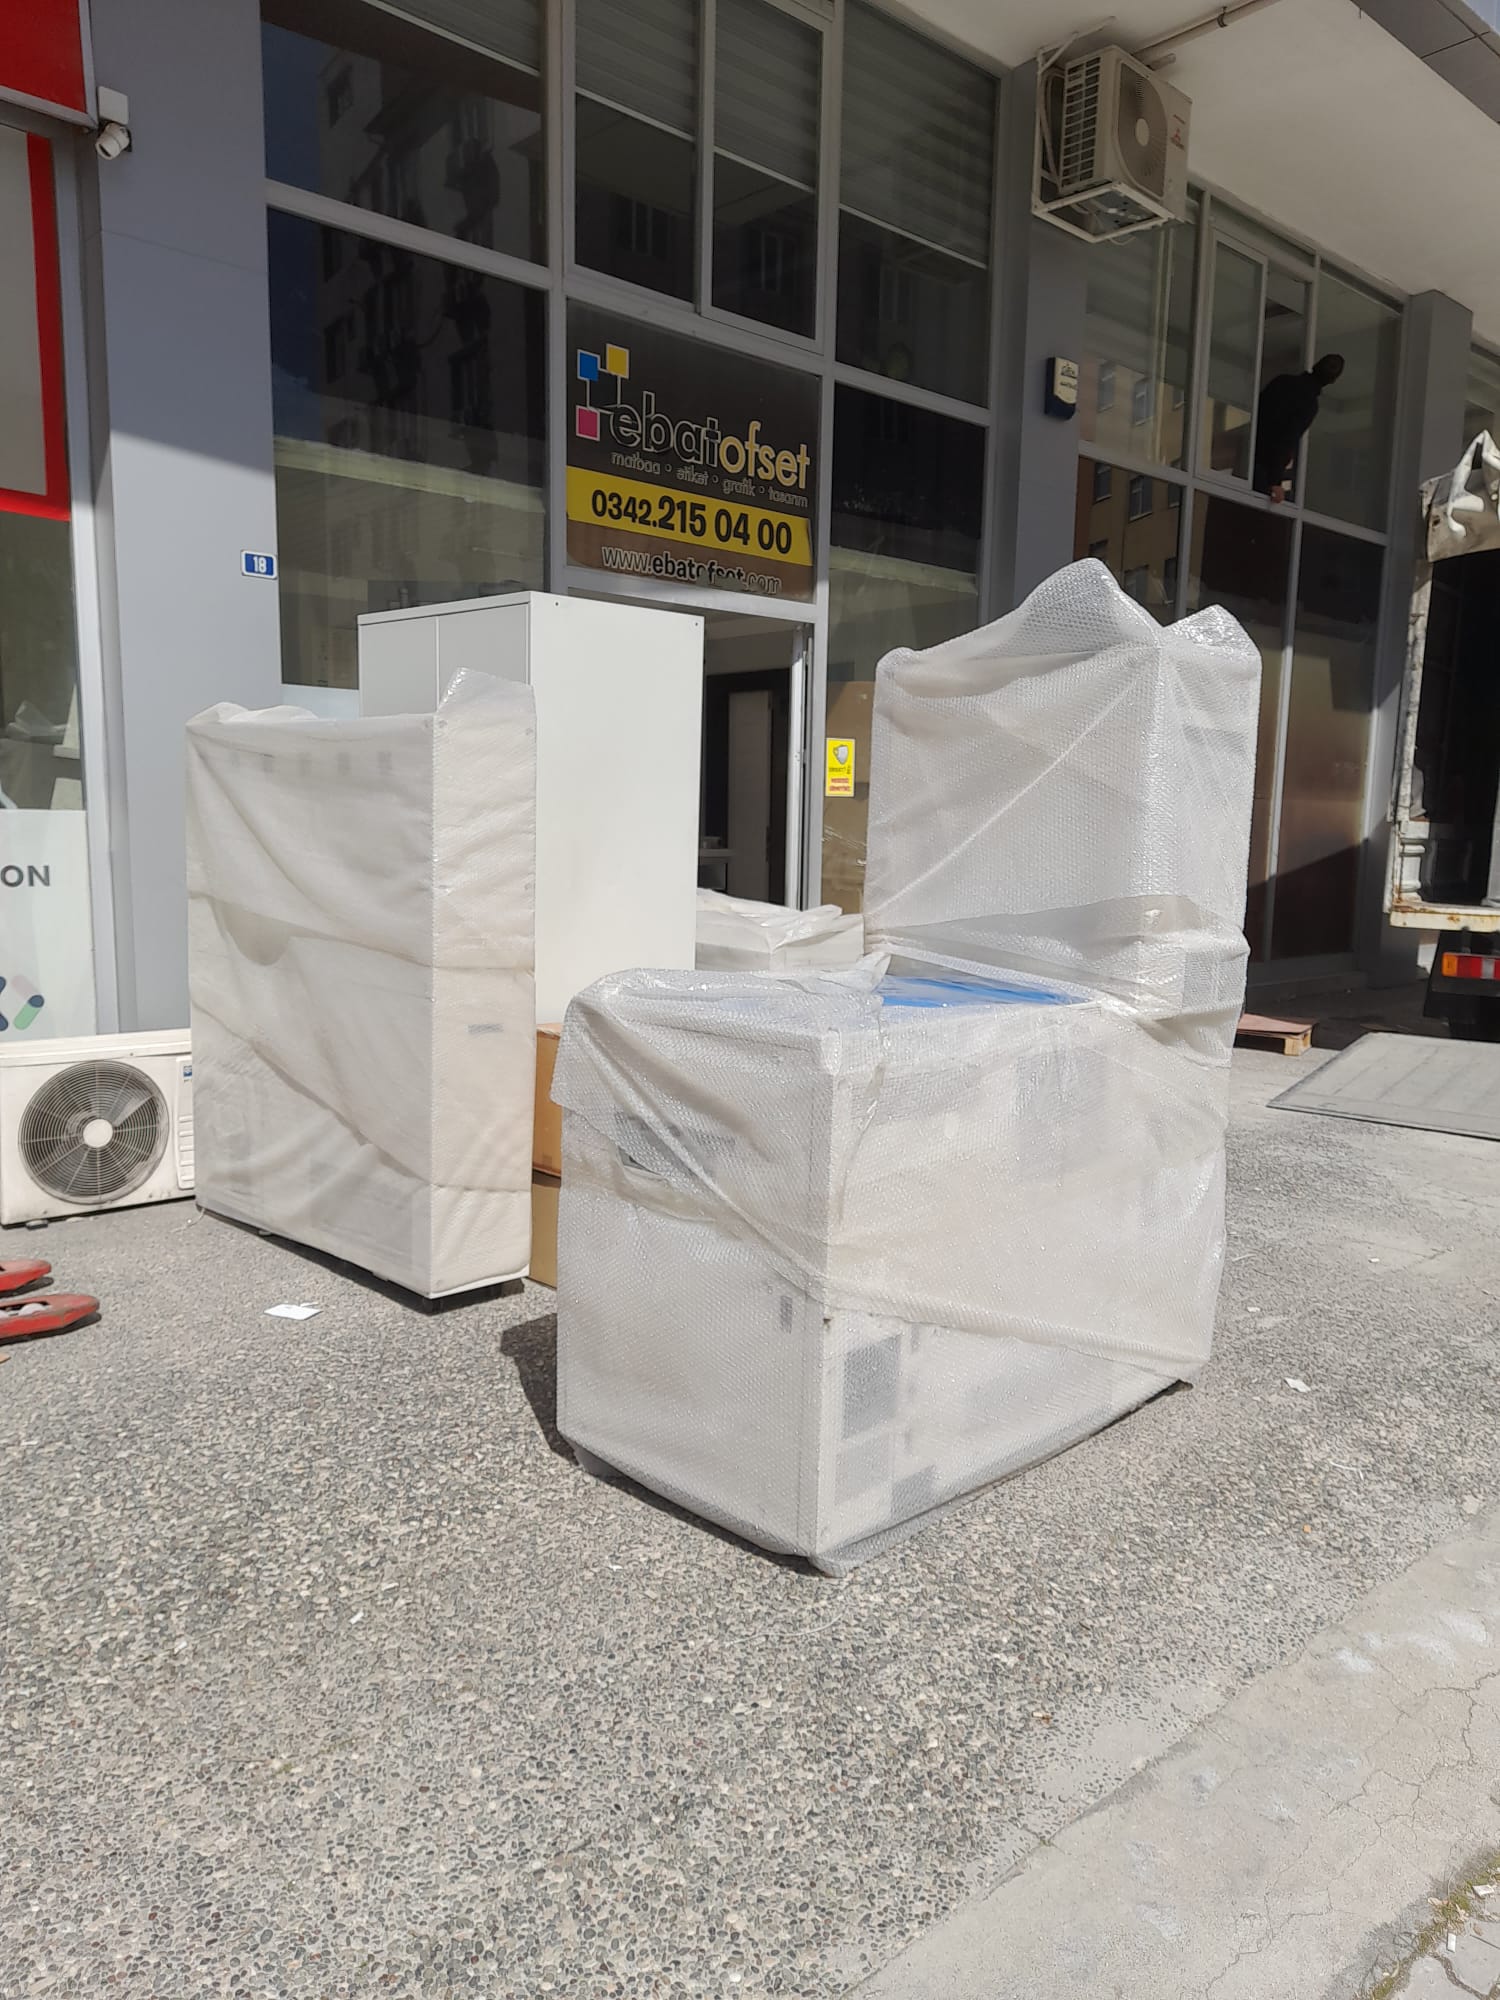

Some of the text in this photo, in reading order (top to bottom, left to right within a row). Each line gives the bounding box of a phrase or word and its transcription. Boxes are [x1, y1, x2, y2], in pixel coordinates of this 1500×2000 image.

[609, 391, 810, 488] ebatofset
[611, 452, 661, 475] matbaa
[676, 465, 709, 486] etiket
[723, 478, 756, 497] grafik
[591, 489, 793, 554] 0342.215 04 00
[253, 556, 267, 573] 18
